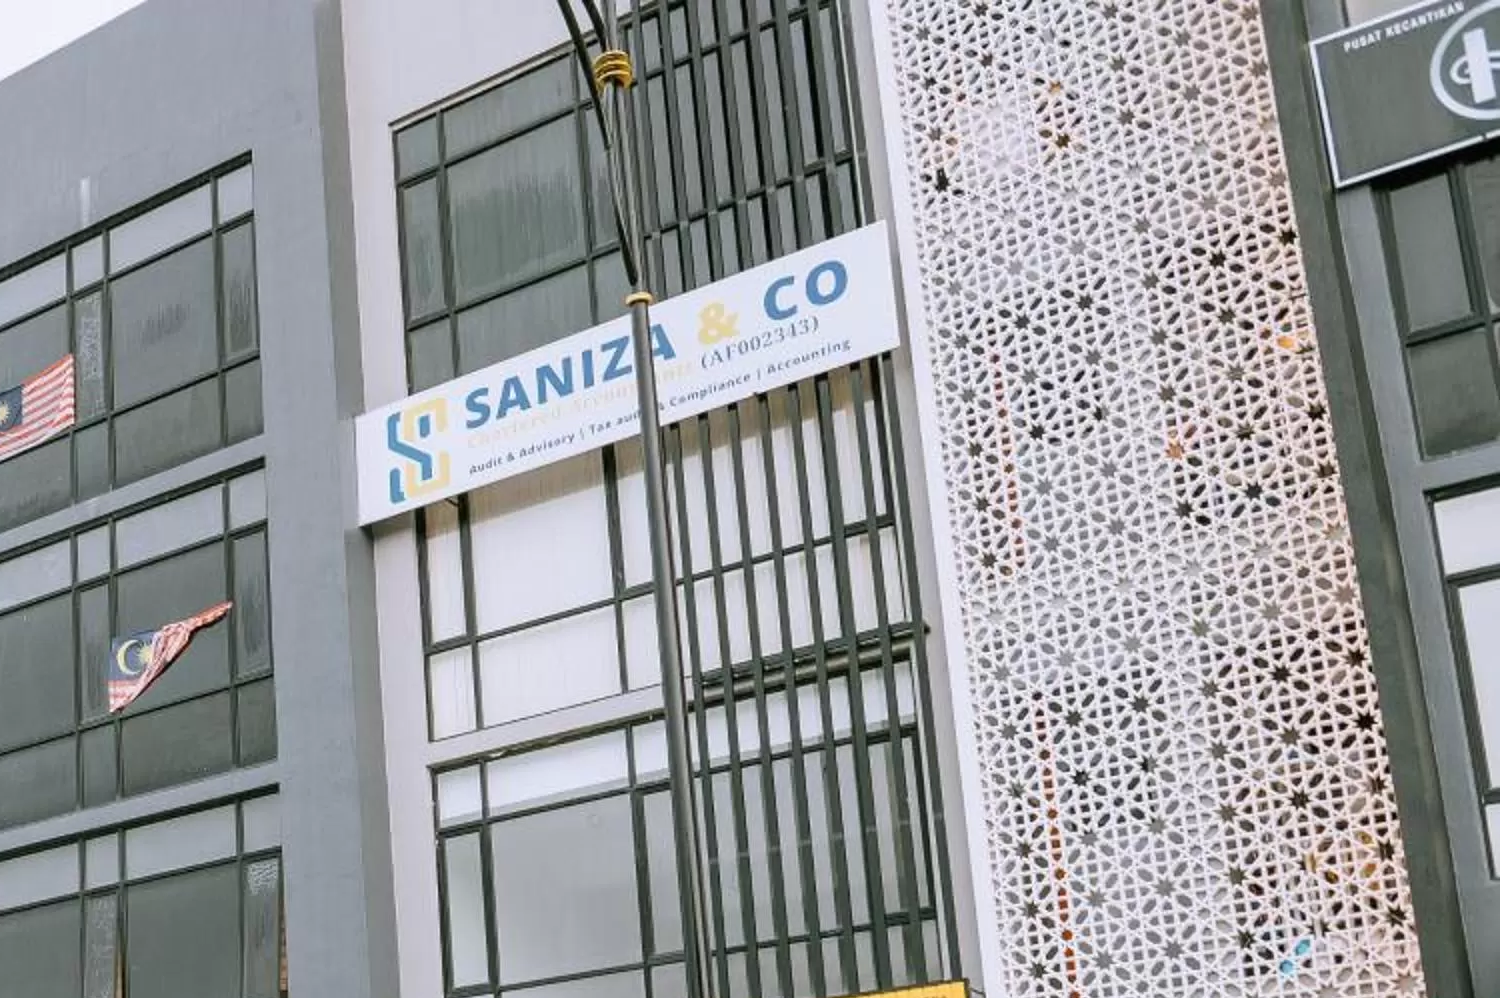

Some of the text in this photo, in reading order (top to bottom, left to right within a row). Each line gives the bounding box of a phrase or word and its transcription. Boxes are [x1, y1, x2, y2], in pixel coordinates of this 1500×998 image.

[1343, 1, 1465, 53] PUSAT KECANTIKAN
[465, 259, 849, 430] SANIZA & CO
[700, 315, 819, 370] (AF002343)
[469, 456, 503, 475] Audit
[520, 432, 575, 458] Advisory
[589, 420, 612, 436] Tax
[669, 372, 751, 407] Compliance
[767, 339, 852, 374] Accounting
